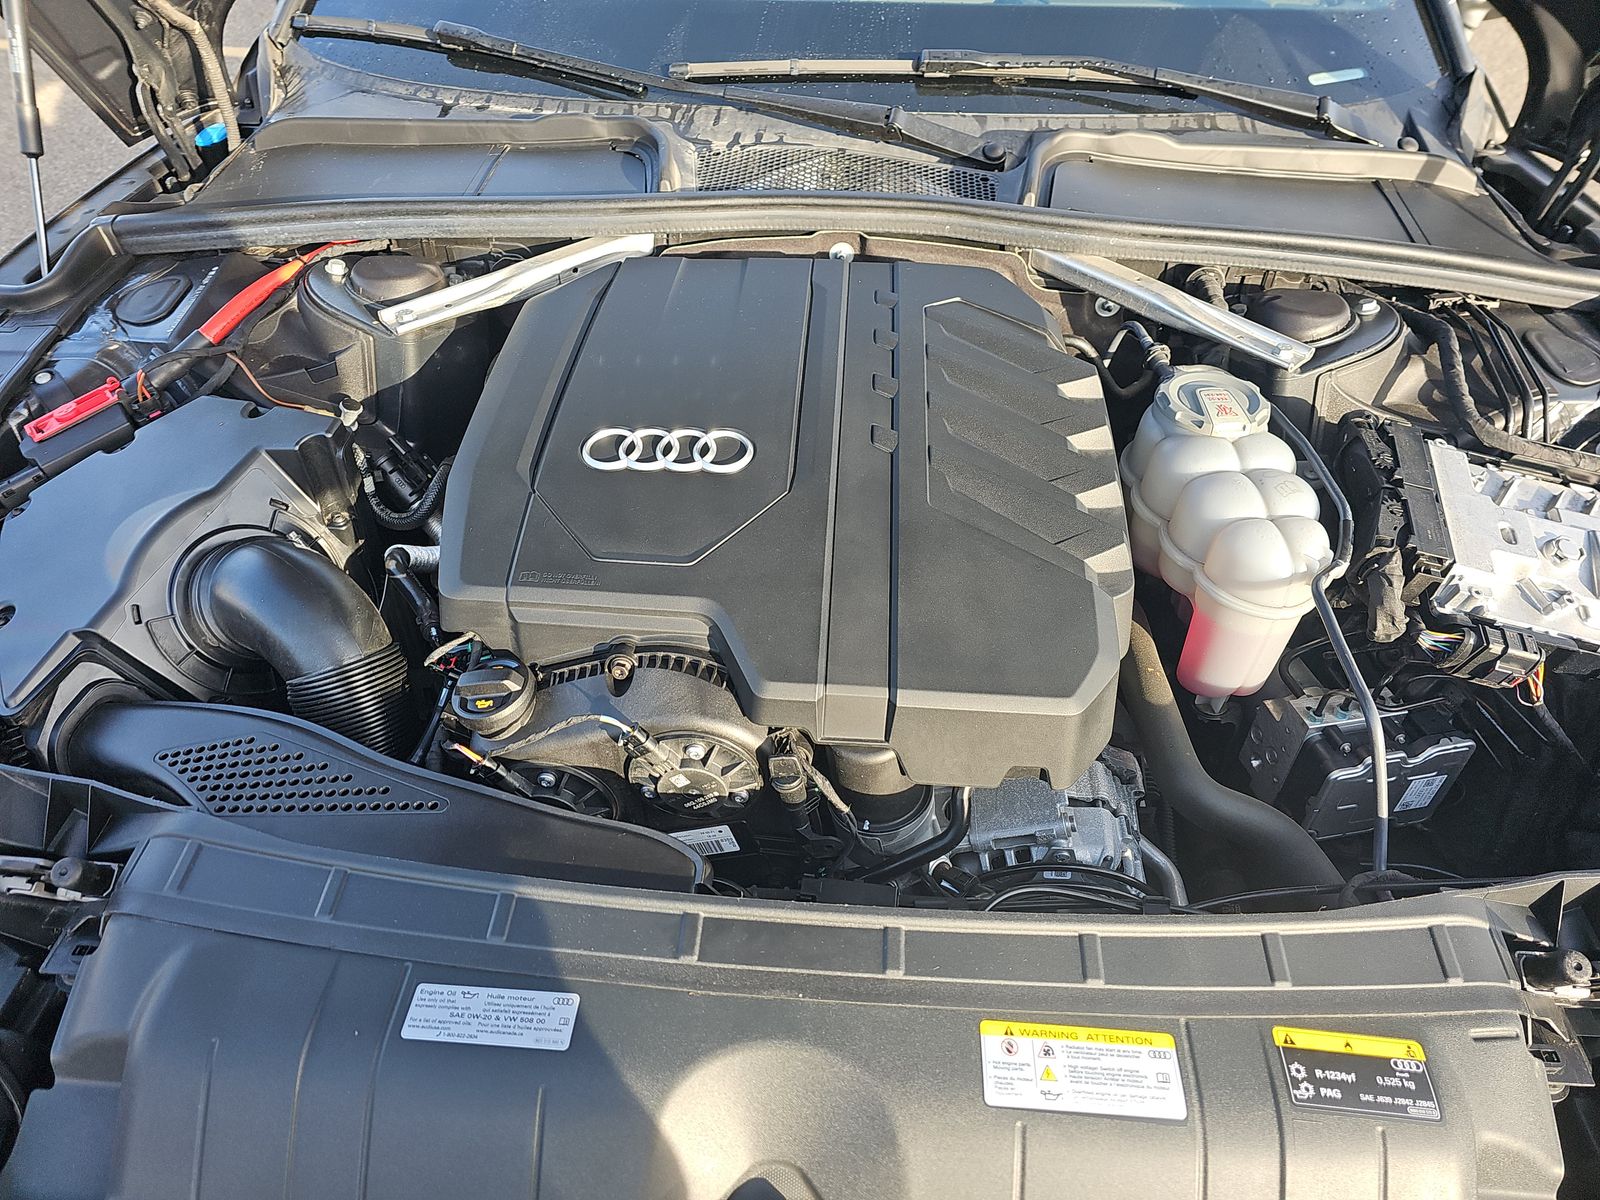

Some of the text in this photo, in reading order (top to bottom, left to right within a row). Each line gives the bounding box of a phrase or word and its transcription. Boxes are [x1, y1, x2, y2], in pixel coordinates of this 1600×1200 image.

[420, 988, 444, 996] Engine
[1019, 1028, 1152, 1046] WARNING ATTENTION
[1314, 1069, 1356, 1084] R-1234yf
[1376, 1076, 1416, 1090] 0,525 kg
[1320, 1087, 1342, 1099] PAG
[1360, 1094, 1375, 1102] SAE
